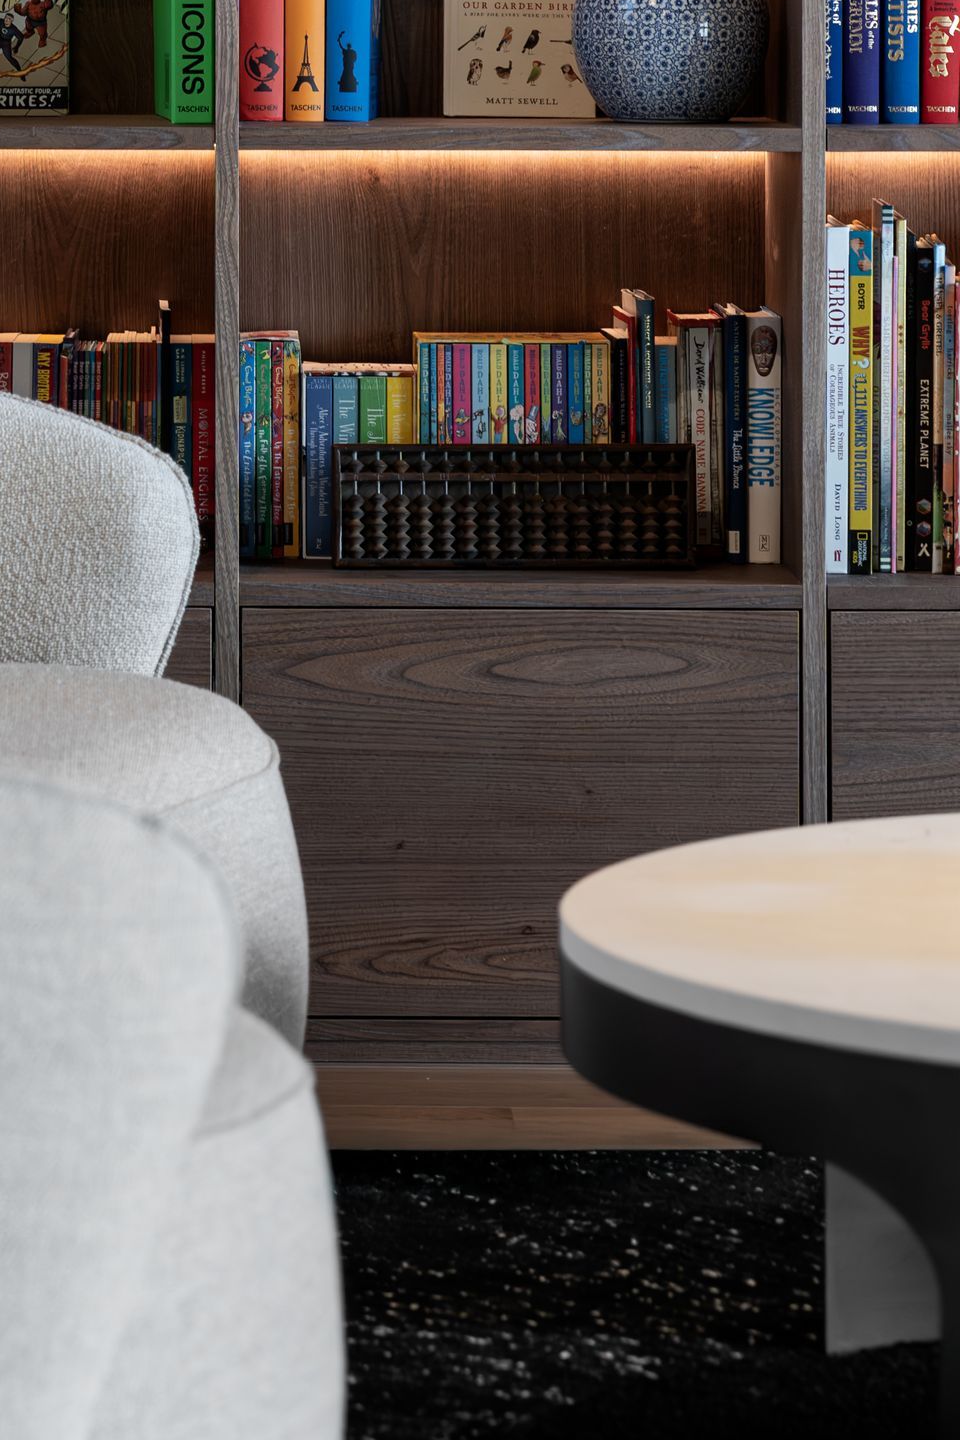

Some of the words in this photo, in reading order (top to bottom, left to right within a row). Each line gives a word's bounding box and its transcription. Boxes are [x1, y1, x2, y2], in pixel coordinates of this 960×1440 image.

[463, 1, 488, 10] OUR
[494, 1, 542, 10] GARDEN
[833, 14, 842, 26] of
[181, 3, 205, 95] ICONS
[929, 15, 960, 77] Tales
[177, 104, 210, 113] TASCHEN
[486, 97, 514, 105] MATT
[518, 97, 559, 106] SEWELL
[828, 269, 846, 345] HEROES
[857, 283, 865, 310] BOYER
[922, 300, 931, 321] Bear
[852, 326, 870, 369] WHY?
[920, 324, 931, 350] Grylls
[36, 352, 50, 366] MY
[853, 378, 867, 408] 1,111
[920, 380, 930, 426] EXTREME
[697, 409, 705, 436] CODE
[748, 387, 774, 487] KNOWLEDGE
[855, 409, 867, 448] ANSWERS
[319, 431, 327, 468] Adventures
[697, 440, 705, 468] NAME
[732, 443, 743, 462] Little
[855, 449, 867, 460] TO
[920, 430, 930, 468] PLANET
[198, 467, 209, 521] ENGINES
[855, 461, 867, 511] EVERYTHING
